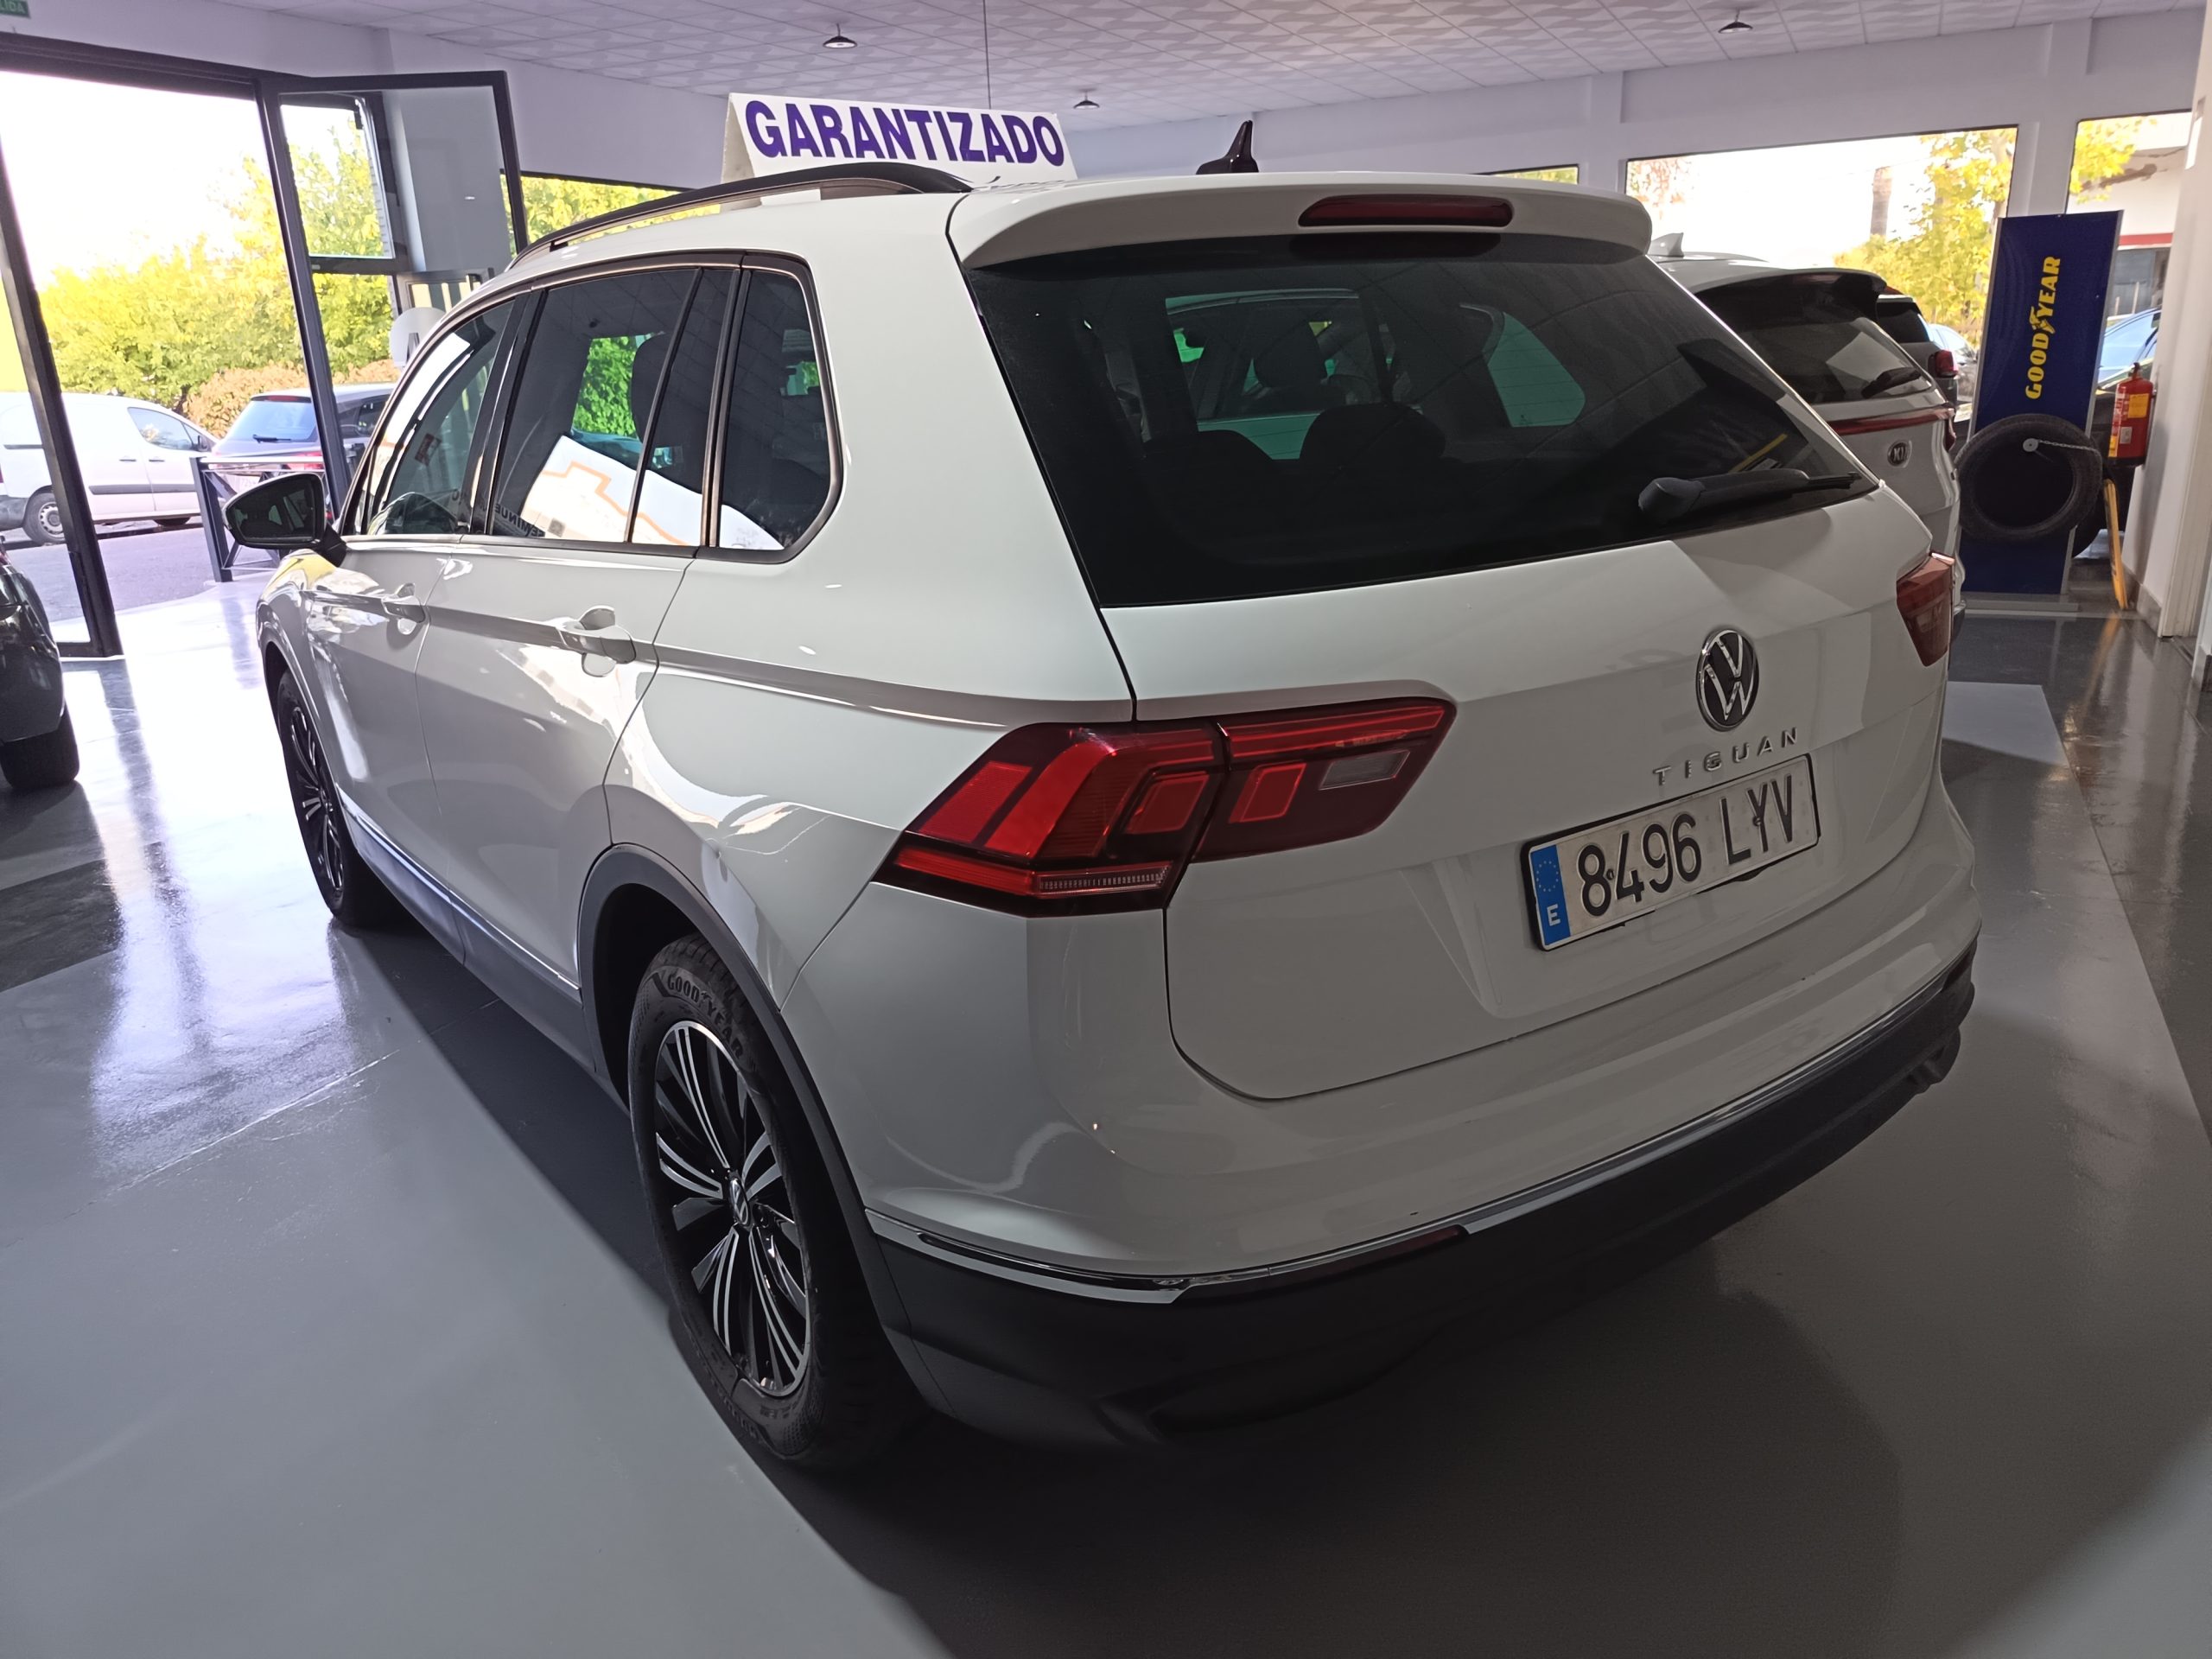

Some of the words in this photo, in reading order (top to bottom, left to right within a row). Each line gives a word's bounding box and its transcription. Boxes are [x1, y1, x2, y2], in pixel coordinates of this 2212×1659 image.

[745, 99, 1065, 167] GARANTIZADO
[2024, 256, 2062, 400] GOODYEAR
[1652, 727, 1799, 786] TIGUAN
[1577, 812, 1702, 918] 8496
[1719, 773, 1794, 866] LYV
[1547, 904, 1561, 927] E
